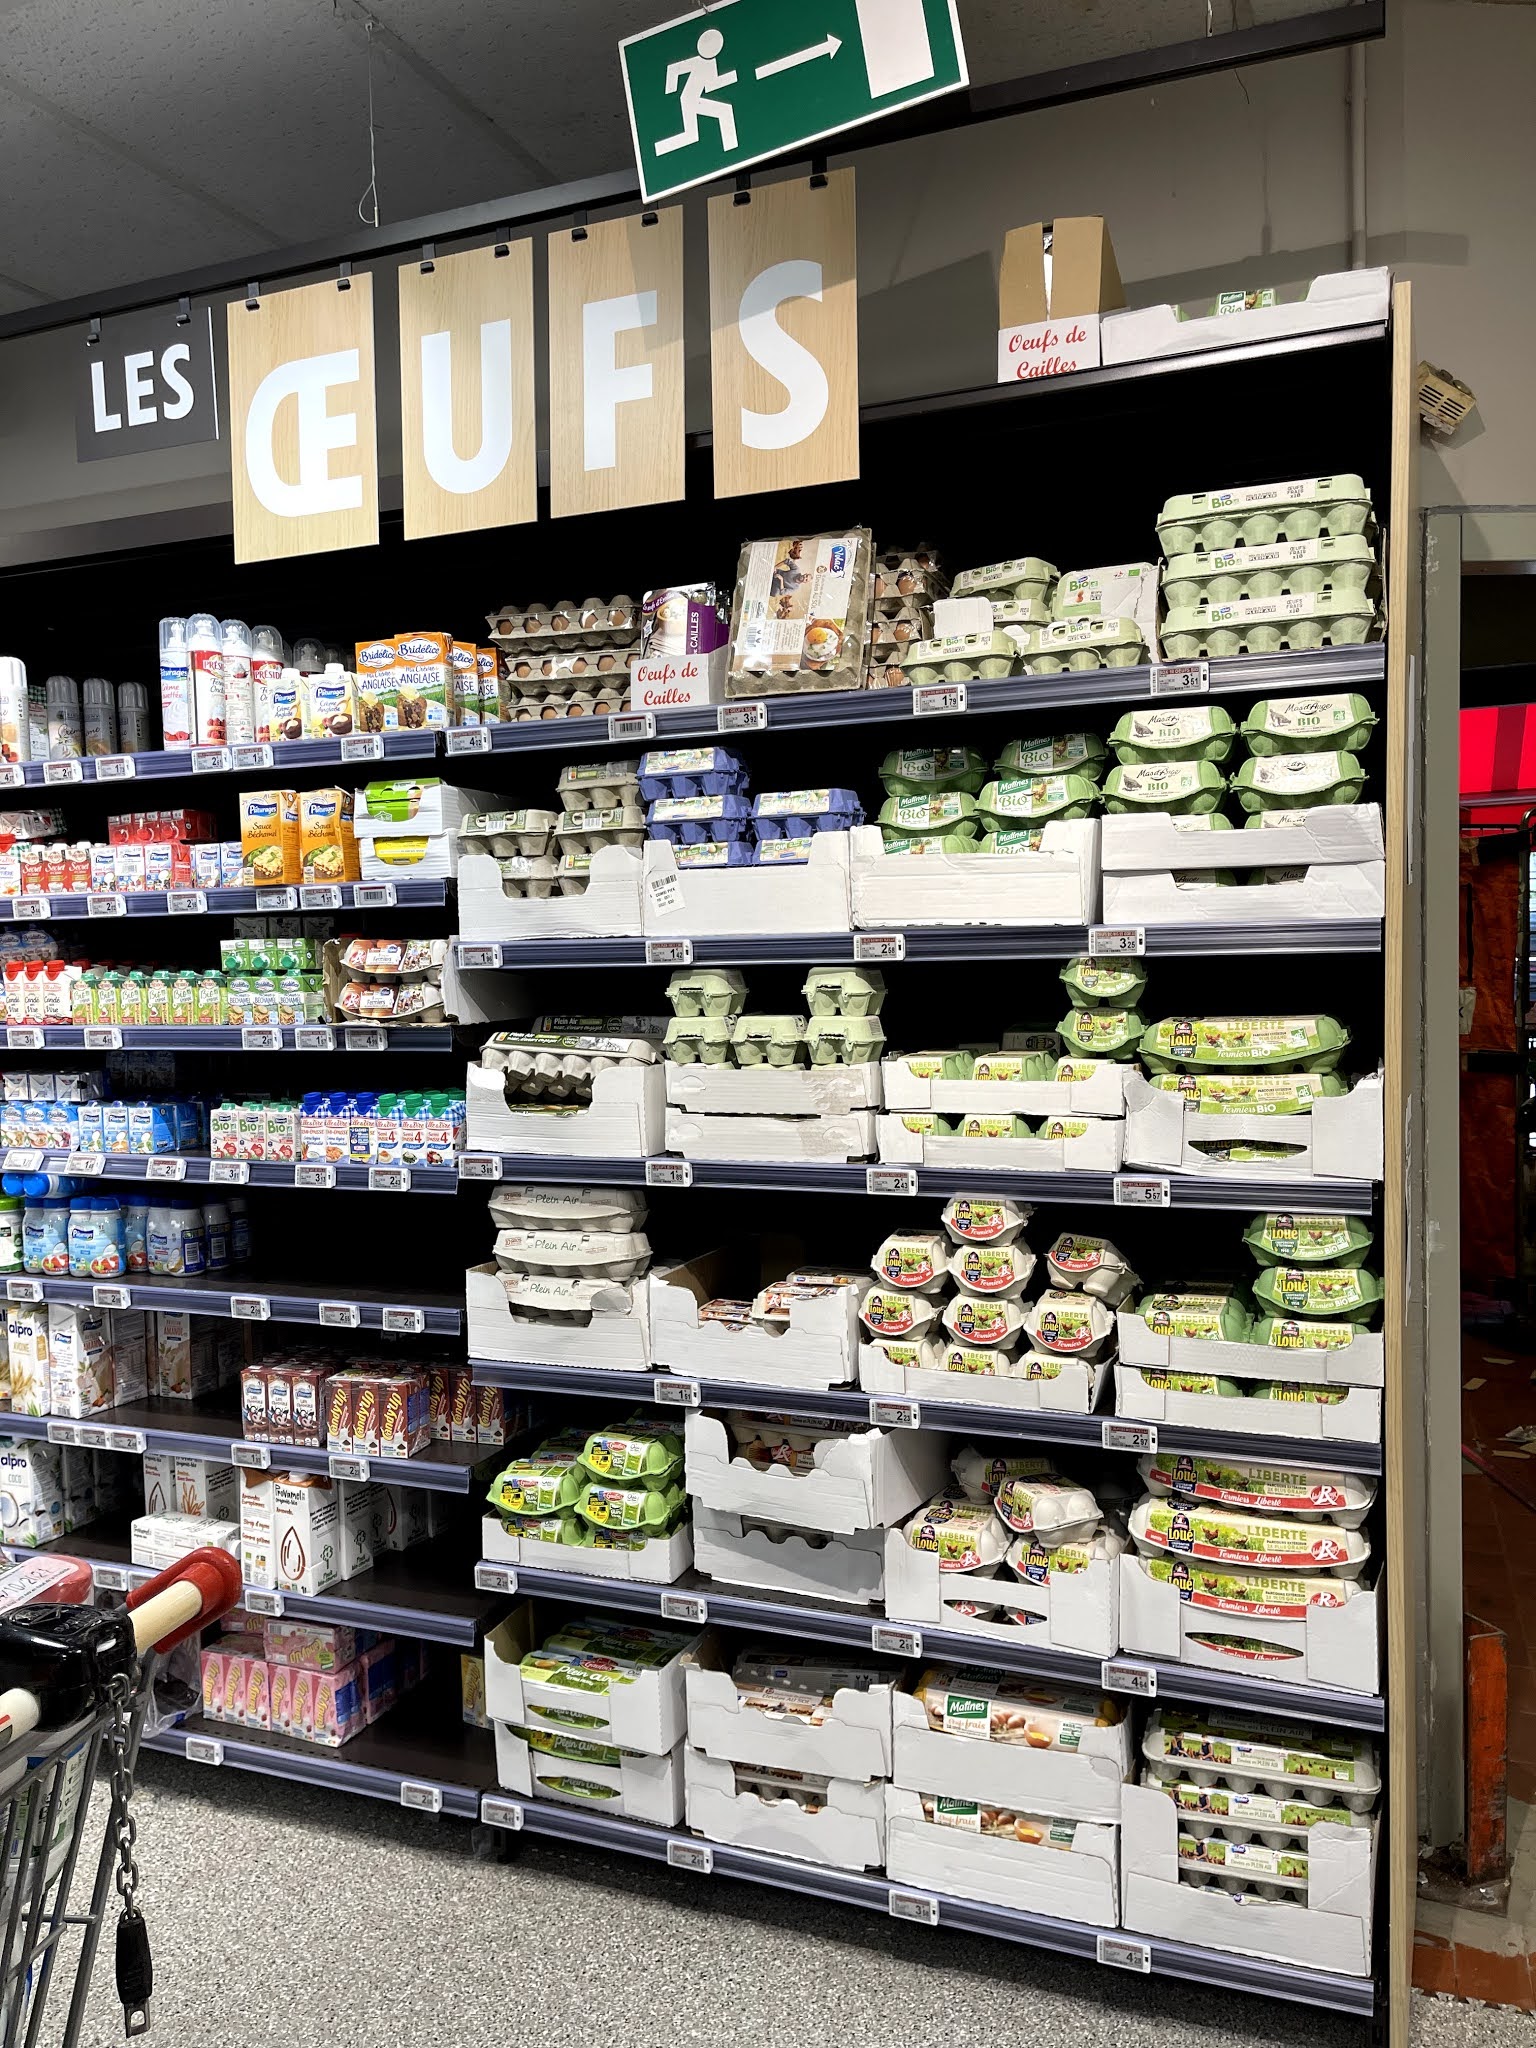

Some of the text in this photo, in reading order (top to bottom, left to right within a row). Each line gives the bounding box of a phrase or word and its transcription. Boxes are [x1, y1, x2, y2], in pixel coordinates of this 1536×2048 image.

[1008, 326, 1087, 357] Oeufs de
[1017, 359, 1077, 384] Cailles
[91, 259, 830, 518] LES ŒUFS
[1069, 579, 1089, 591] Bio
[690, 611, 699, 648] CAILLES
[397, 643, 440, 656] Bridélice
[399, 671, 440, 684] ANGLAISE
[637, 662, 699, 686] Oeufs de
[362, 677, 396, 690] ANGLAISE
[643, 687, 692, 705] Cailles
[1297, 716, 1320, 727] BIO
[1021, 752, 1051, 765] Bio
[999, 778, 1029, 792] Matines
[1148, 781, 1169, 791] BIO
[900, 794, 927, 807] Matines
[998, 793, 1029, 808] Bio
[899, 808, 927, 821] Bio
[998, 830, 1027, 843] Matines
[1252, 1049, 1271, 1058] BIO
[1222, 1104, 1276, 1115] Fermiers BIO
[388, 1131, 396, 1143] 4
[415, 1131, 422, 1143] 4
[441, 1131, 448, 1144] 4
[535, 1194, 579, 1205] Plein Air
[1272, 1228, 1298, 1240] Loué
[535, 1240, 577, 1252] Plein Air
[530, 1284, 568, 1297] Plein Air
[1281, 1280, 1309, 1293] Loué
[1335, 1298, 1348, 1307] BIO
[9, 1320, 33, 1338] alpro
[1276, 1335, 1304, 1348] Loué
[1, 1453, 27, 1470] alpro
[1172, 1467, 1198, 1482] Loué
[1248, 1467, 1307, 1487] LIBERTÉ
[1219, 1490, 1250, 1504] Fermiers
[1254, 1495, 1282, 1507] Liberté
[1168, 1528, 1194, 1542] Loué
[1247, 1525, 1307, 1541] LIBERTÉ
[916, 1537, 939, 1551] Loué
[1026, 1553, 1049, 1567] Loué
[1218, 1548, 1282, 1564] Fermiers Liberté
[1245, 1575, 1306, 1594] LIBERTÉ
[1217, 1598, 1280, 1615] Fermiers Liberté
[555, 1665, 588, 1679] plein
[949, 1701, 986, 1714] Matines
